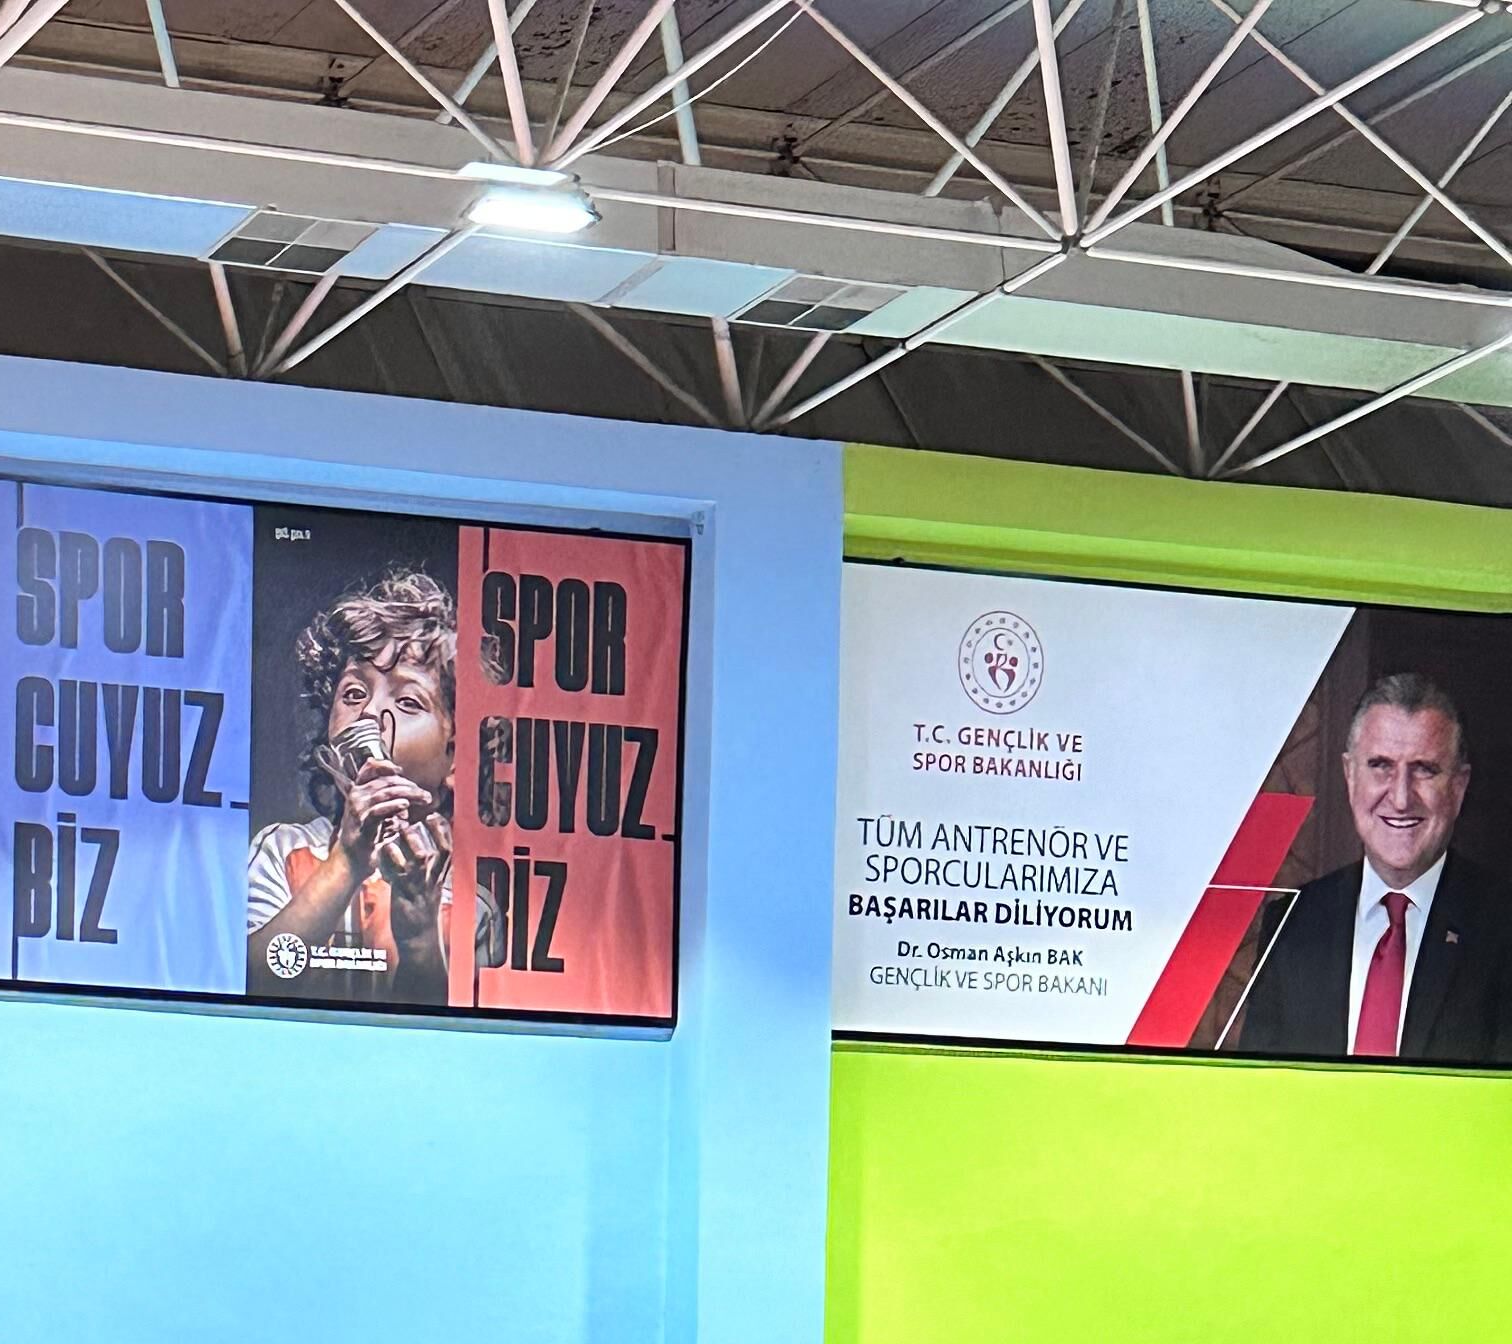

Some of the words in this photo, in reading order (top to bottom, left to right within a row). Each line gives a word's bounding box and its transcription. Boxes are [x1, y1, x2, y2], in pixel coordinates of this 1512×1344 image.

[16, 527, 185, 658] SPOR
[480, 571, 627, 695] SPOR
[15, 676, 224, 807] CUYUZ
[913, 724, 950, 744] T.C.
[958, 726, 1049, 753] GENÇLİK
[1056, 733, 1083, 753] VE
[478, 715, 659, 840] CUYUZ
[913, 752, 966, 773] SPOR
[972, 756, 1082, 781] BAKANLIĞI
[857, 814, 922, 850] TÜM
[931, 823, 1088, 859] ANTRENÖR
[1094, 834, 1129, 862] VE
[13, 812, 120, 944] BİZ
[865, 854, 1119, 896] SPORCULARIMIZA
[475, 846, 568, 973] BİZ
[848, 894, 988, 924] BAŞARILAR
[995, 898, 1133, 931] DİLİYORUM
[897, 941, 923, 958] Dr.
[927, 943, 988, 961] Osman
[993, 946, 1041, 967] Aşkın
[1047, 949, 1083, 966] BAK
[870, 965, 951, 991] GENÇLİK
[955, 970, 978, 989] VE
[983, 972, 1033, 992] SPOR
[1038, 975, 1108, 996] BAKANI
